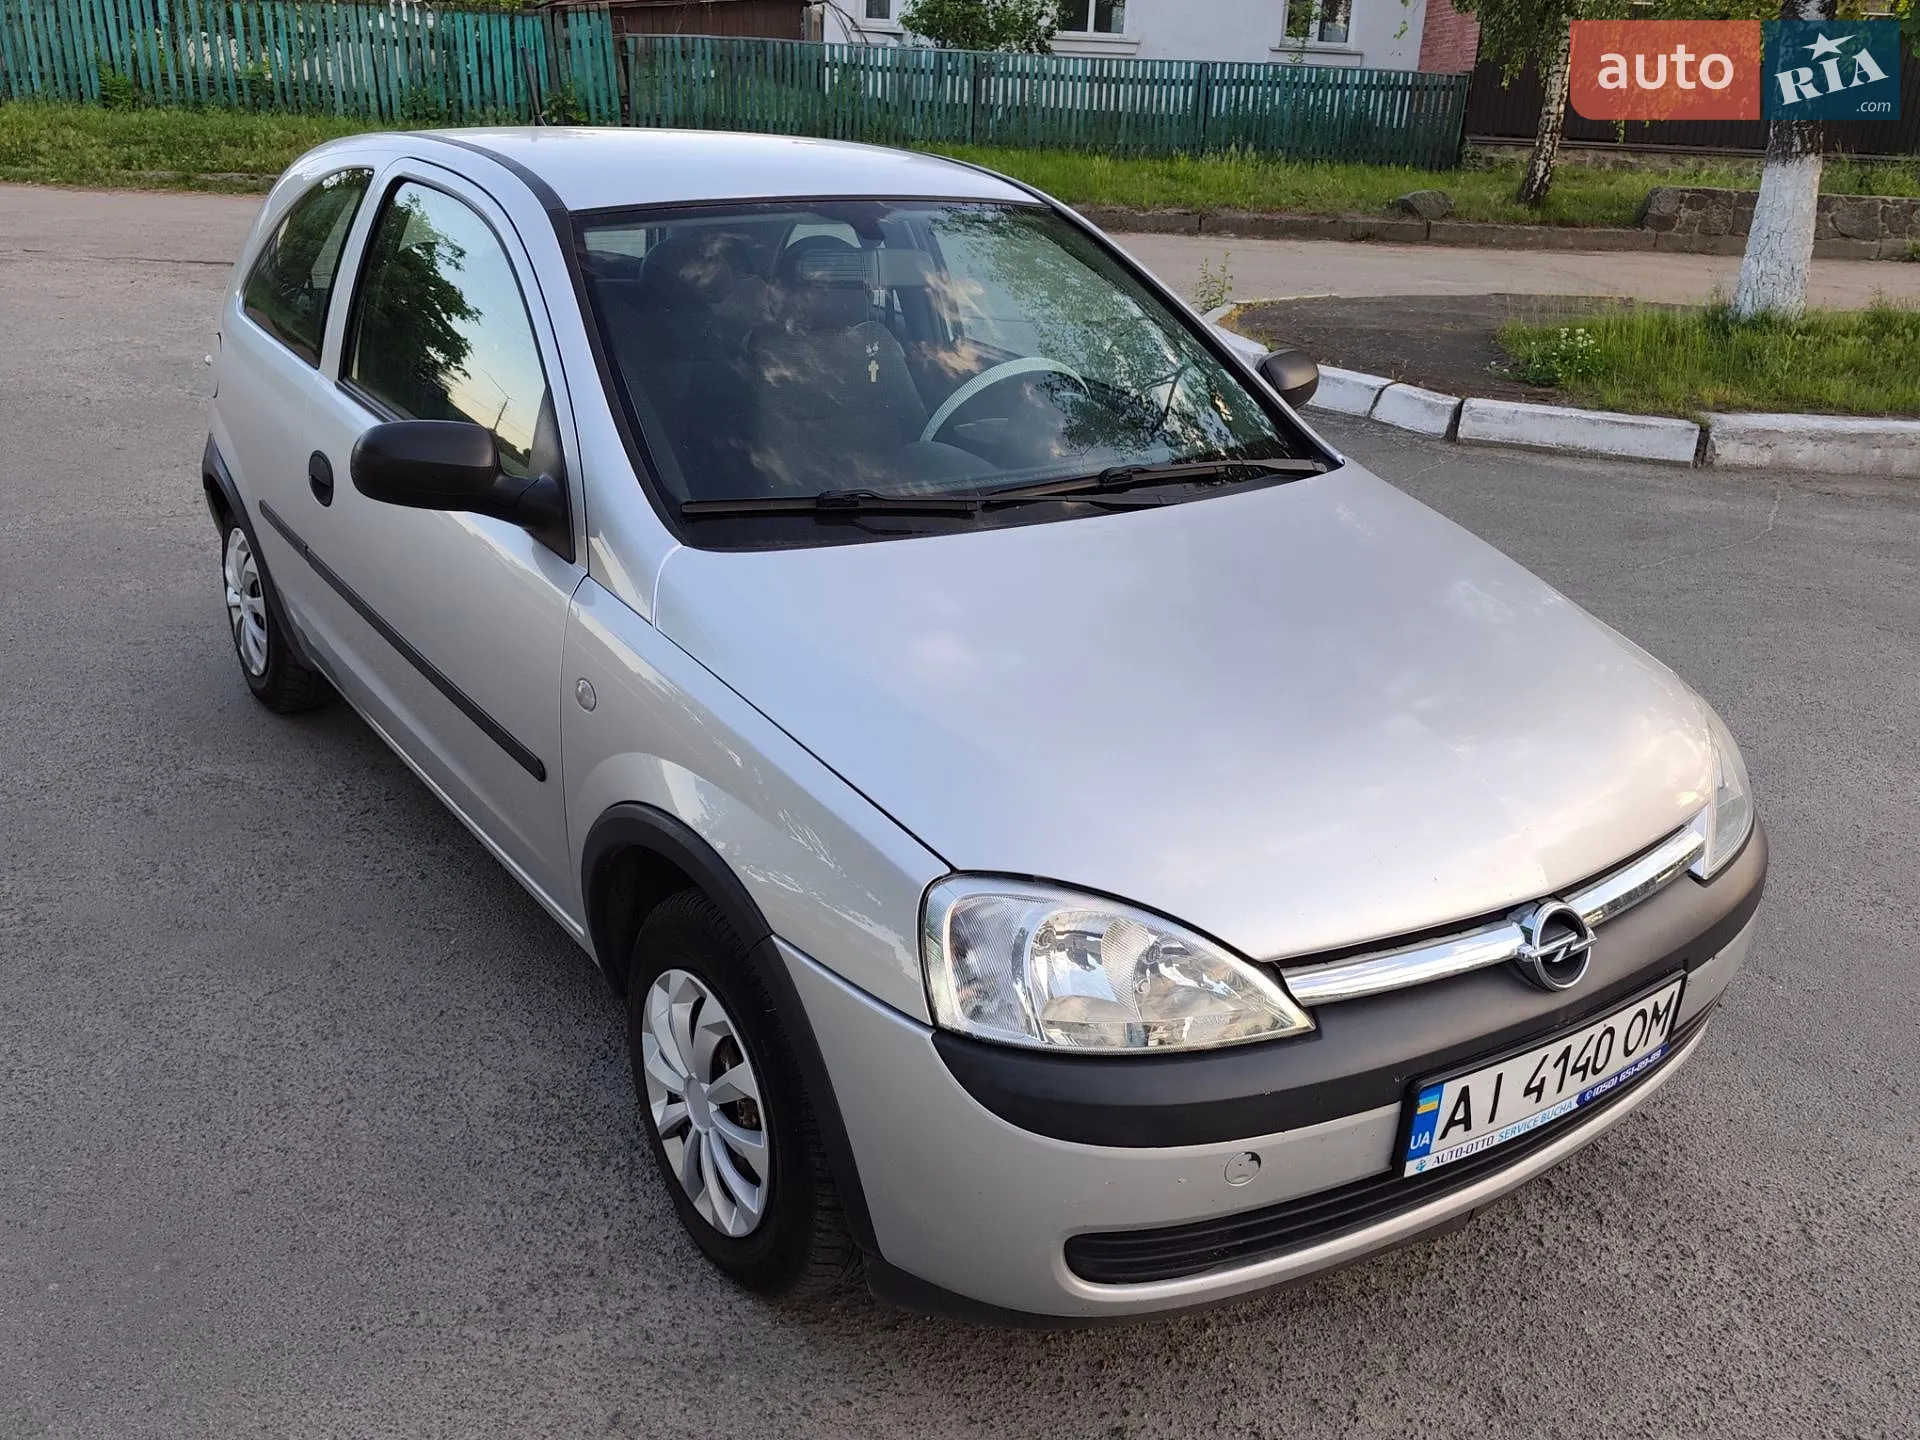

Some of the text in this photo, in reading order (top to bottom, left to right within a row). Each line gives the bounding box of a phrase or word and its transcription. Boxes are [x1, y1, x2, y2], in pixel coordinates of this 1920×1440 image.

[1438, 990, 1676, 1141] AI 4140 OM
[1410, 1131, 1431, 1150] UA
[1431, 1135, 1495, 1167] AUTO-OTTO
[1498, 1114, 1539, 1142] SERVICE
[1540, 1101, 1573, 1123] BUCHA
